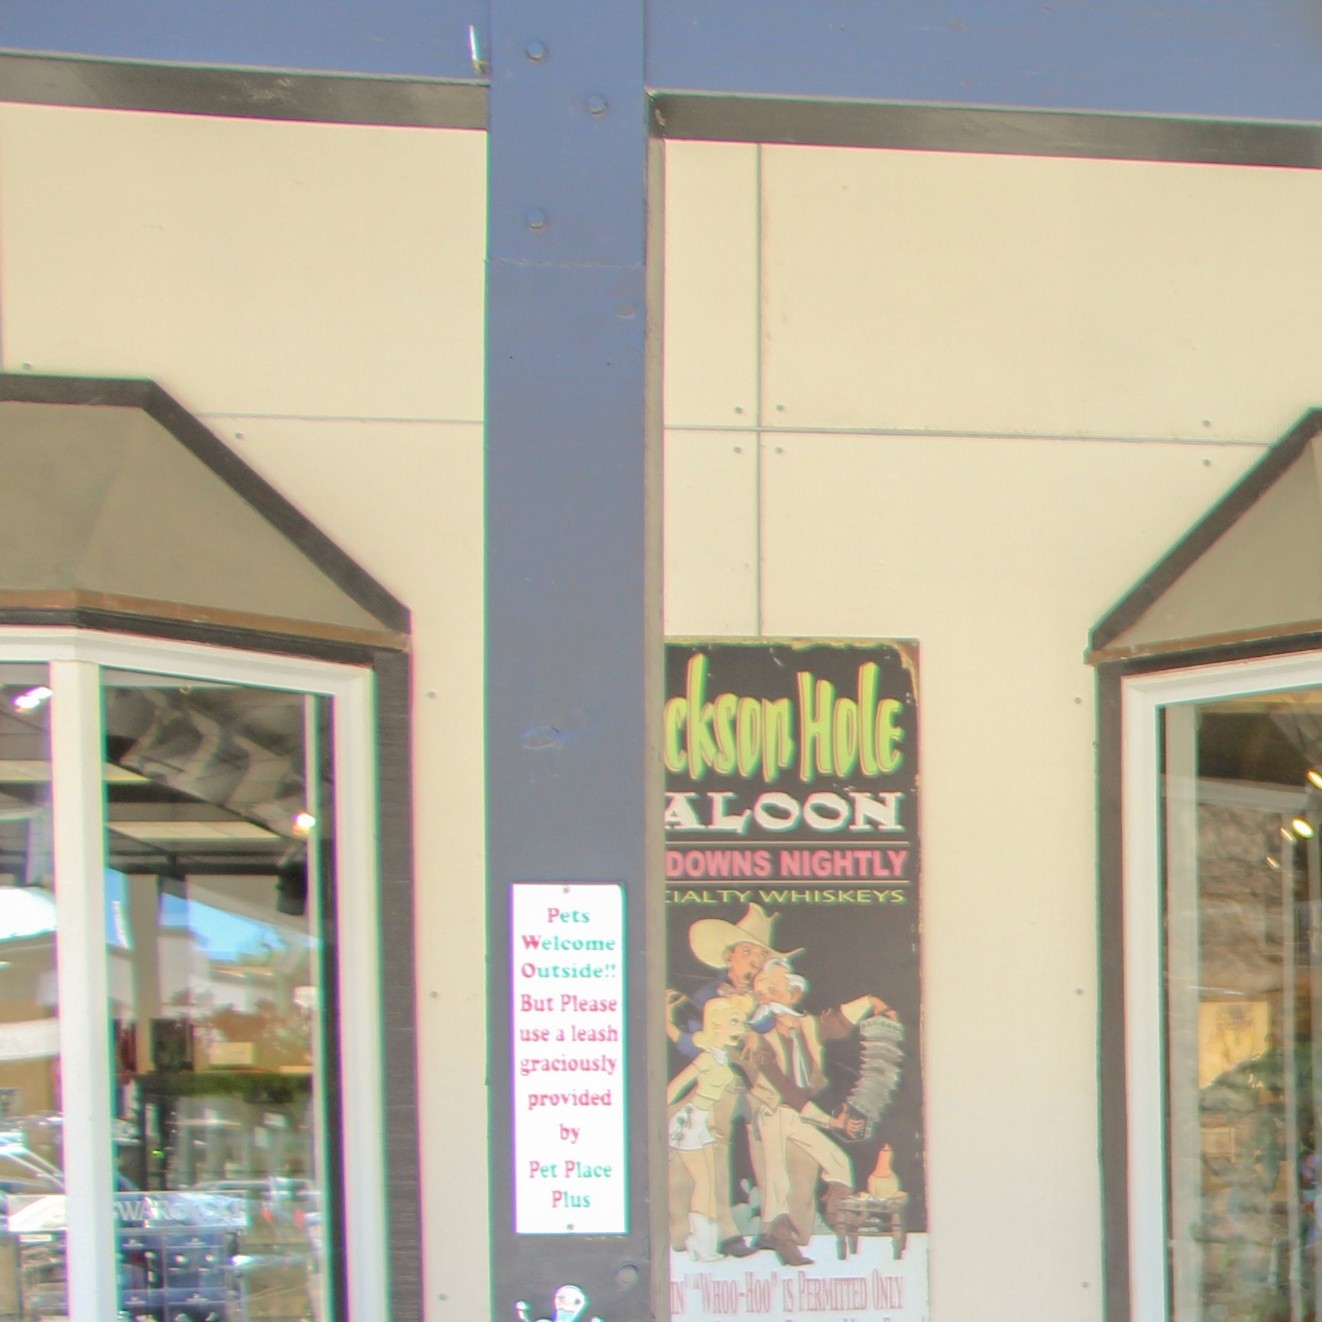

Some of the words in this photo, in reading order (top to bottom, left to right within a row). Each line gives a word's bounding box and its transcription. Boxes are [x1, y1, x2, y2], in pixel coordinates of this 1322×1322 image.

[797, 661, 905, 783] Hole
[780, 849, 908, 878] NIGHTLY
[759, 889, 907, 904] WHISKEYS
[546, 907, 591, 924] Pets
[521, 935, 617, 951] Welcome
[520, 963, 617, 979] Outside!!
[519, 993, 554, 1013] But
[559, 993, 618, 1013] Please
[519, 1028, 550, 1043] use
[555, 1028, 566, 1043] a
[571, 1025, 619, 1043] leash
[519, 1054, 618, 1077] graciously
[527, 1089, 612, 1111] provided
[558, 1123, 581, 1144] by
[528, 1160, 558, 1179] Pet
[563, 1160, 612, 1179] Place
[551, 1190, 592, 1209] Plus
